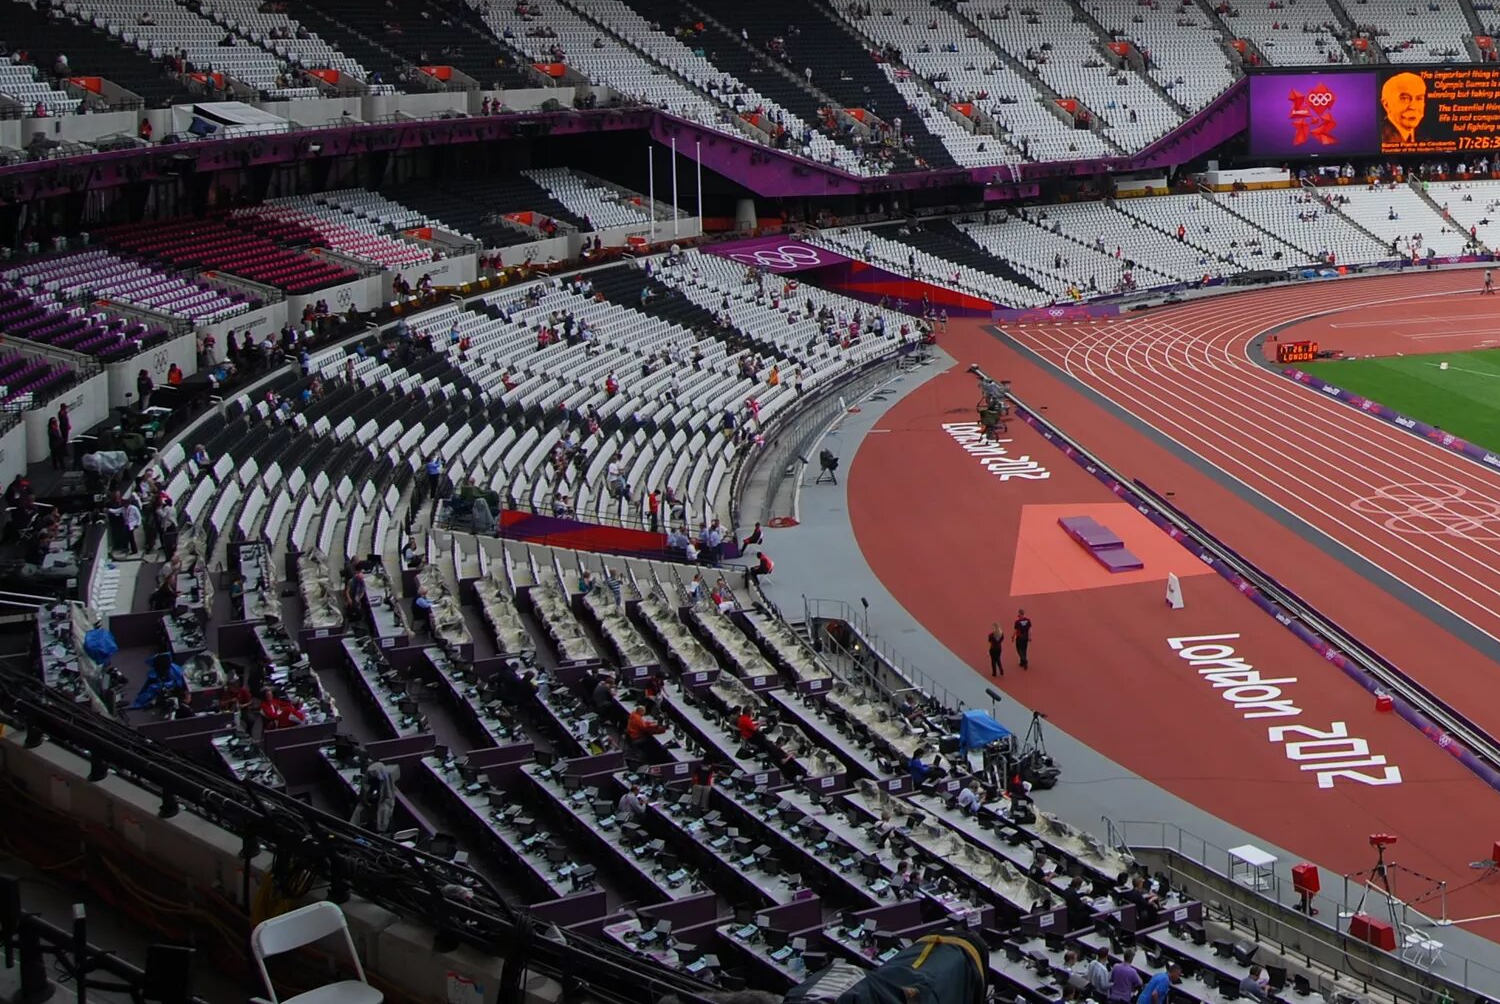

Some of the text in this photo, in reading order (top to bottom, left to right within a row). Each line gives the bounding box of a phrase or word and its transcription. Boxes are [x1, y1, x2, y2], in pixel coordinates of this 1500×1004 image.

[1283, 353, 1313, 361] LONDON
[980, 455, 1051, 481] 2012
[1167, 633, 1403, 789] London 2012
